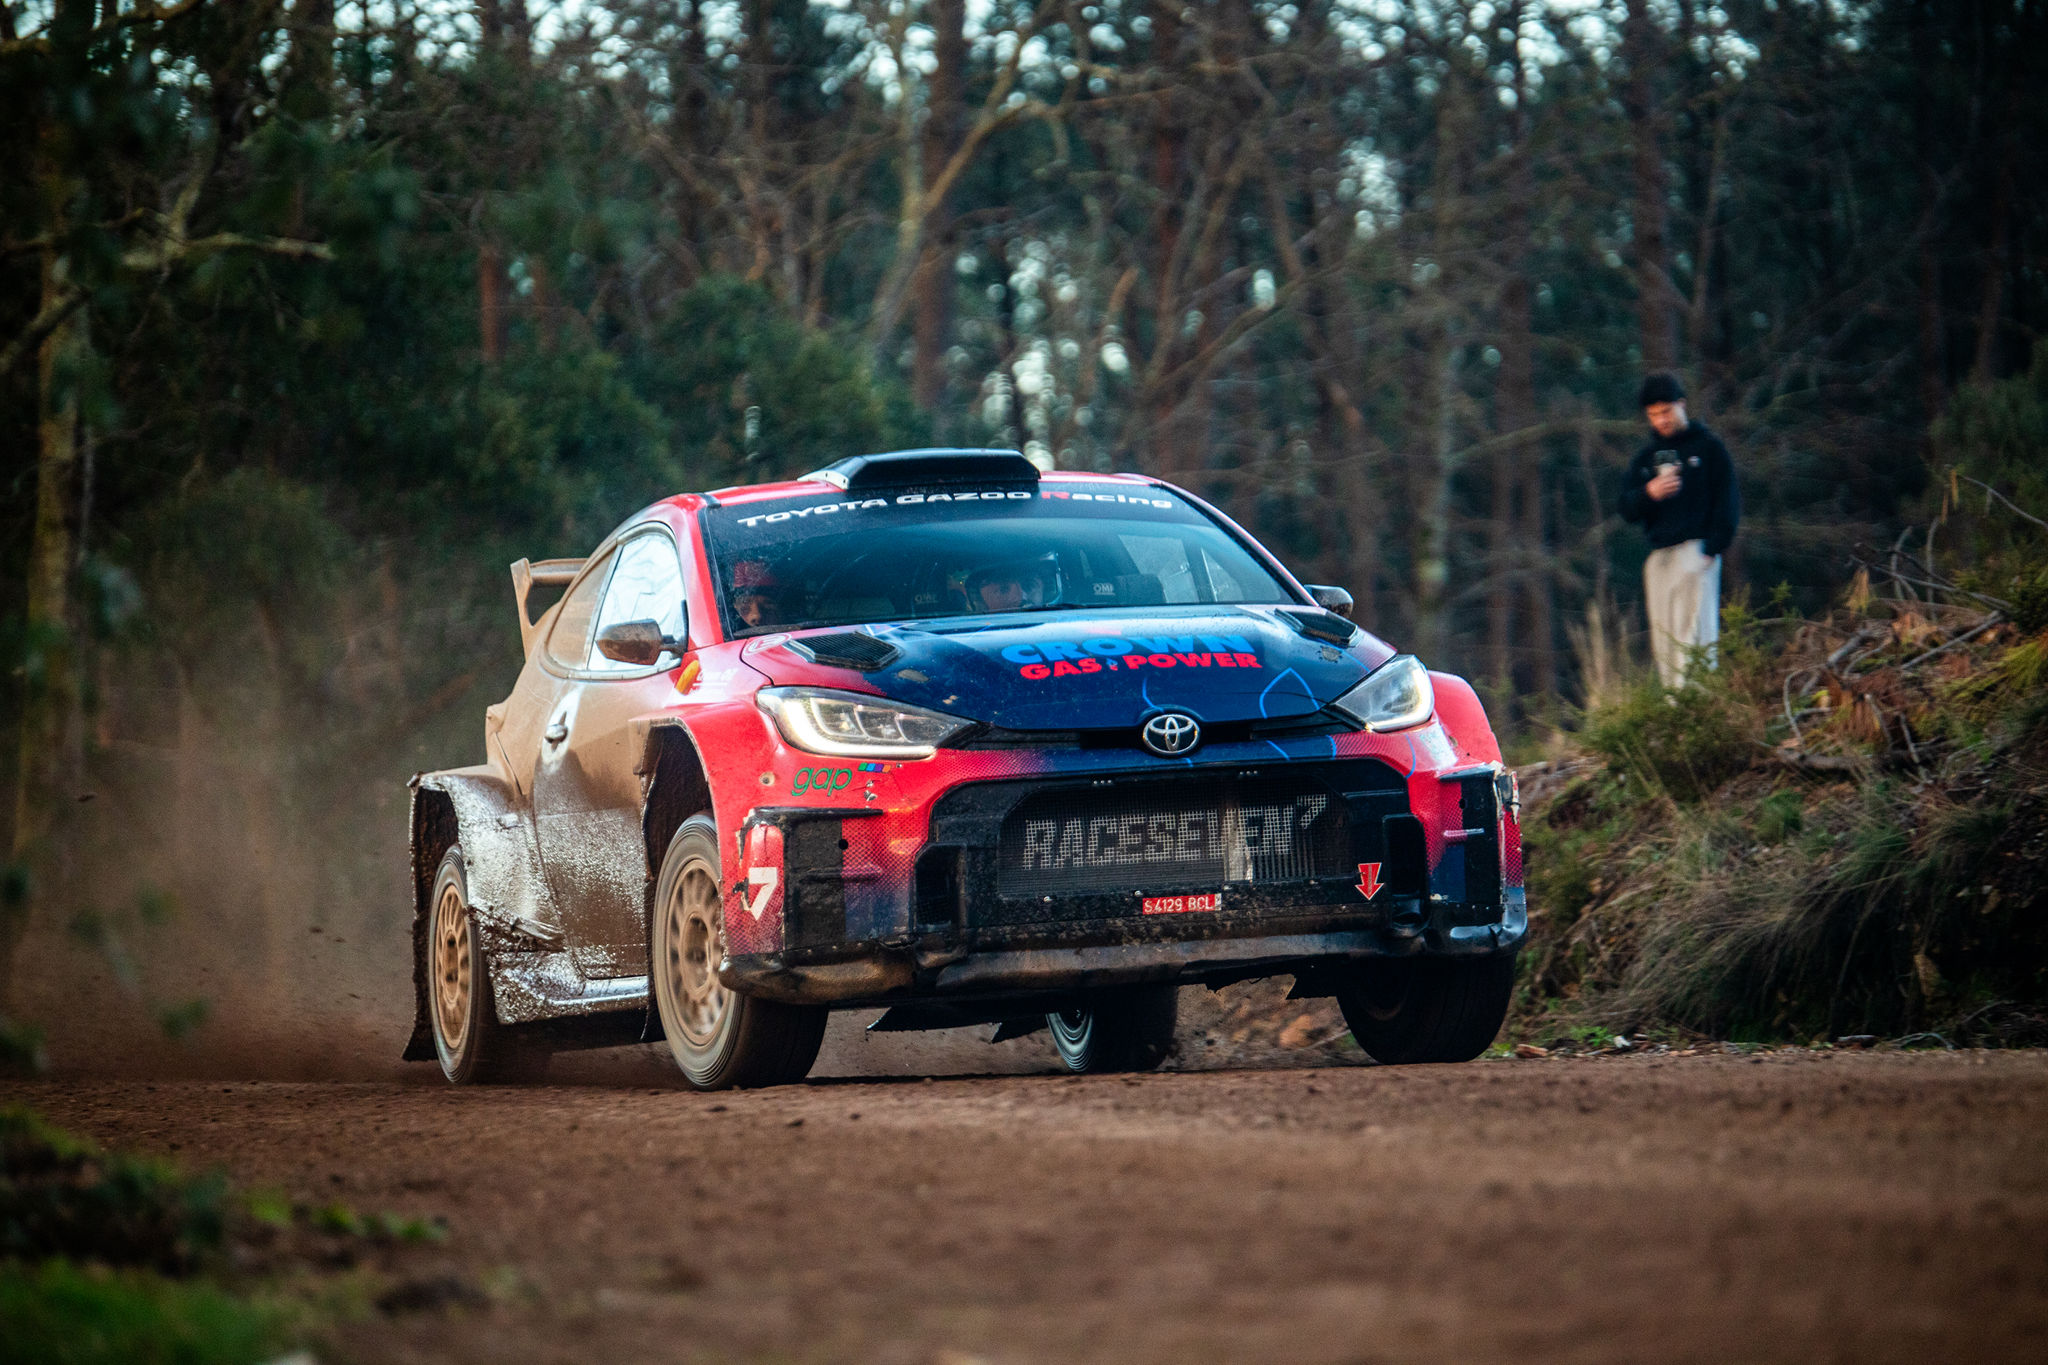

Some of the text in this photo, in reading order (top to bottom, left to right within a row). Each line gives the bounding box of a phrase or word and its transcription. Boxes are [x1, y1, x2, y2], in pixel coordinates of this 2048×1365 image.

[737, 498, 888, 527] TOYOTA
[896, 493, 1032, 504] GAZOO
[1001, 634, 1255, 664] CROWN
[1020, 652, 1263, 680] GAS POWER
[791, 767, 853, 797] gap
[748, 867, 778, 920] 7
[1188, 896, 1213, 911] BCL
